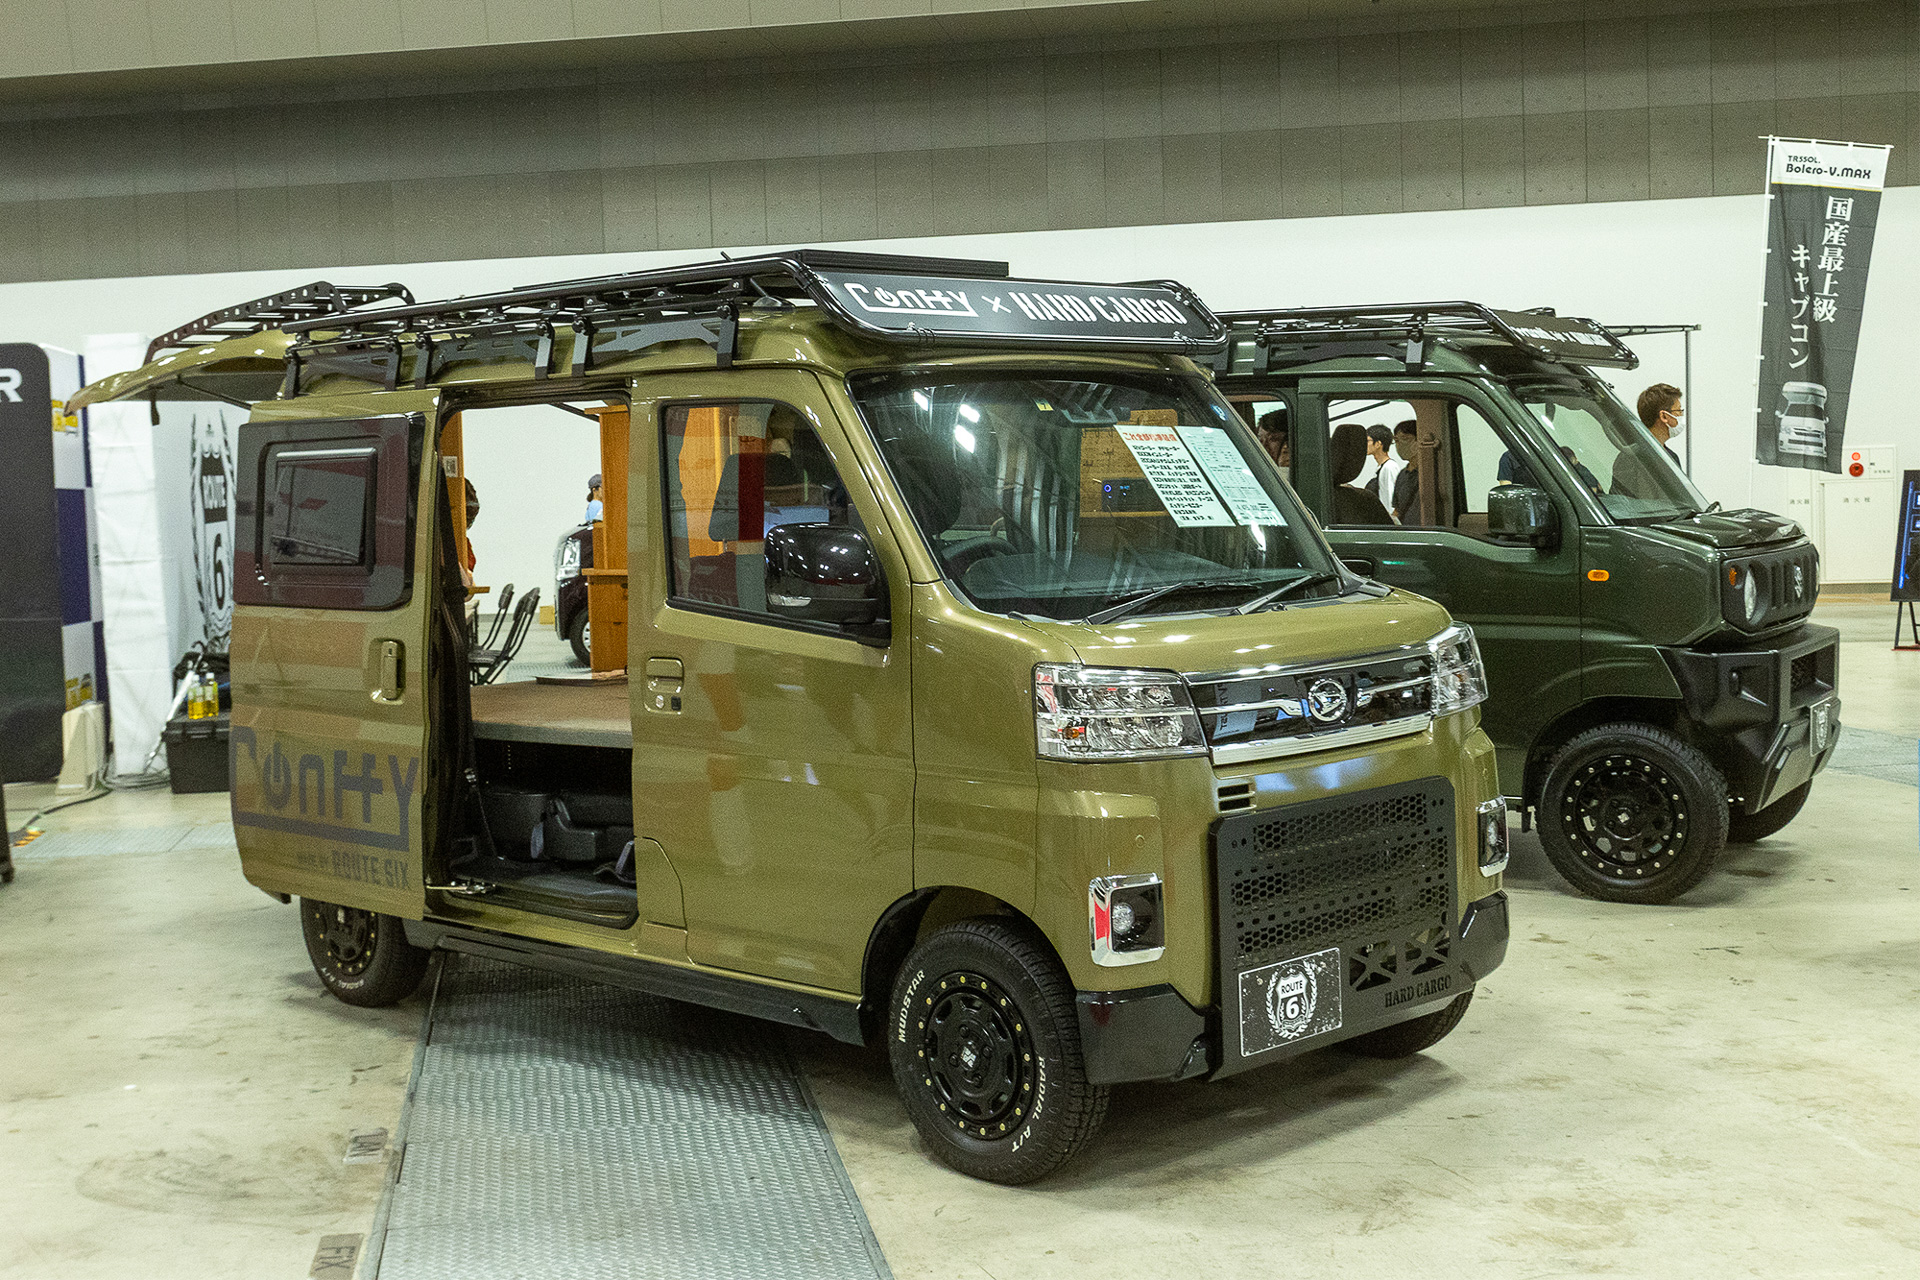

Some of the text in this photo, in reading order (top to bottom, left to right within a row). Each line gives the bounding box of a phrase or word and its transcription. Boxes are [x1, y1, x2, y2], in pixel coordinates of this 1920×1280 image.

[1812, 195, 1854, 324] 国産最上級
[1008, 291, 1097, 322] HARD
[1088, 295, 1188, 324] CARGO
[1789, 244, 1811, 369] キャブコン
[383, 858, 410, 889] SIX
[1281, 980, 1303, 994] ROUTE
[1384, 975, 1452, 1008] HARD CARGO
[898, 970, 925, 1042] MUDSTAR
[1286, 996, 1299, 1019] 6
[1012, 1056, 1046, 1152] RADIAL A/T
[315, 1245, 356, 1271] FIX
